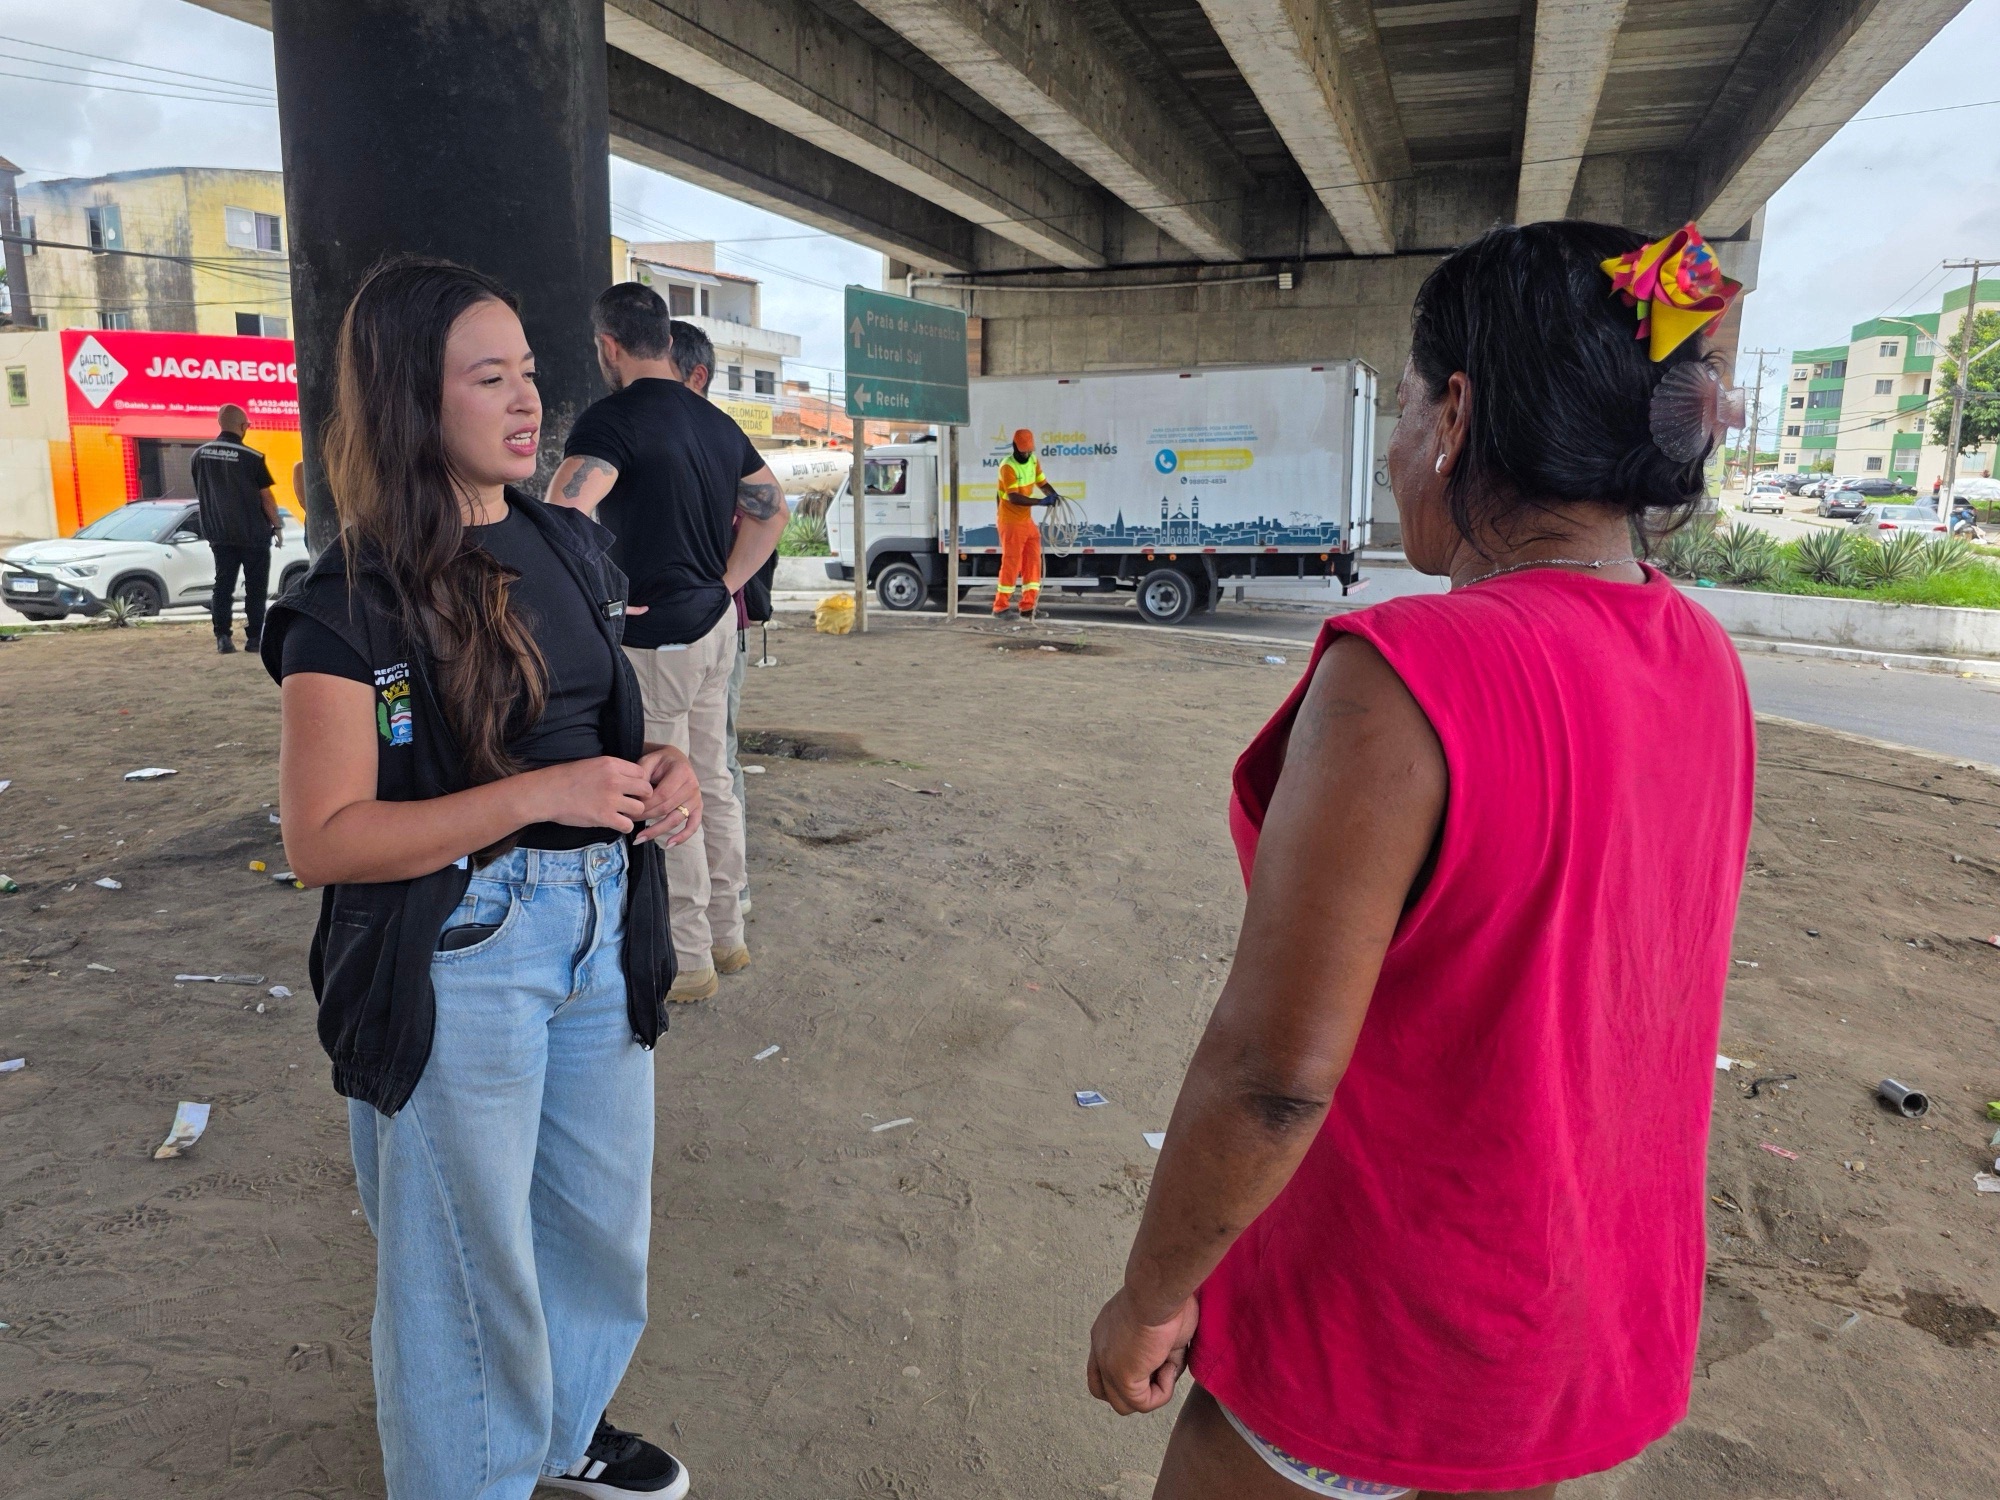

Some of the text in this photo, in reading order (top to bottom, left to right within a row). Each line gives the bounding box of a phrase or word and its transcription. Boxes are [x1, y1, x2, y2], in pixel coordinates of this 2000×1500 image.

[866, 310, 894, 330] Praia
[897, 317, 909, 332] de
[80, 354, 109, 367] GALETO
[867, 342, 922, 365] Litoral Sul
[97, 371, 114, 385] LUIZ
[876, 390, 910, 408] Recife
[1041, 431, 1087, 443] Cidade
[1041, 443, 1118, 457] deTodosNós
